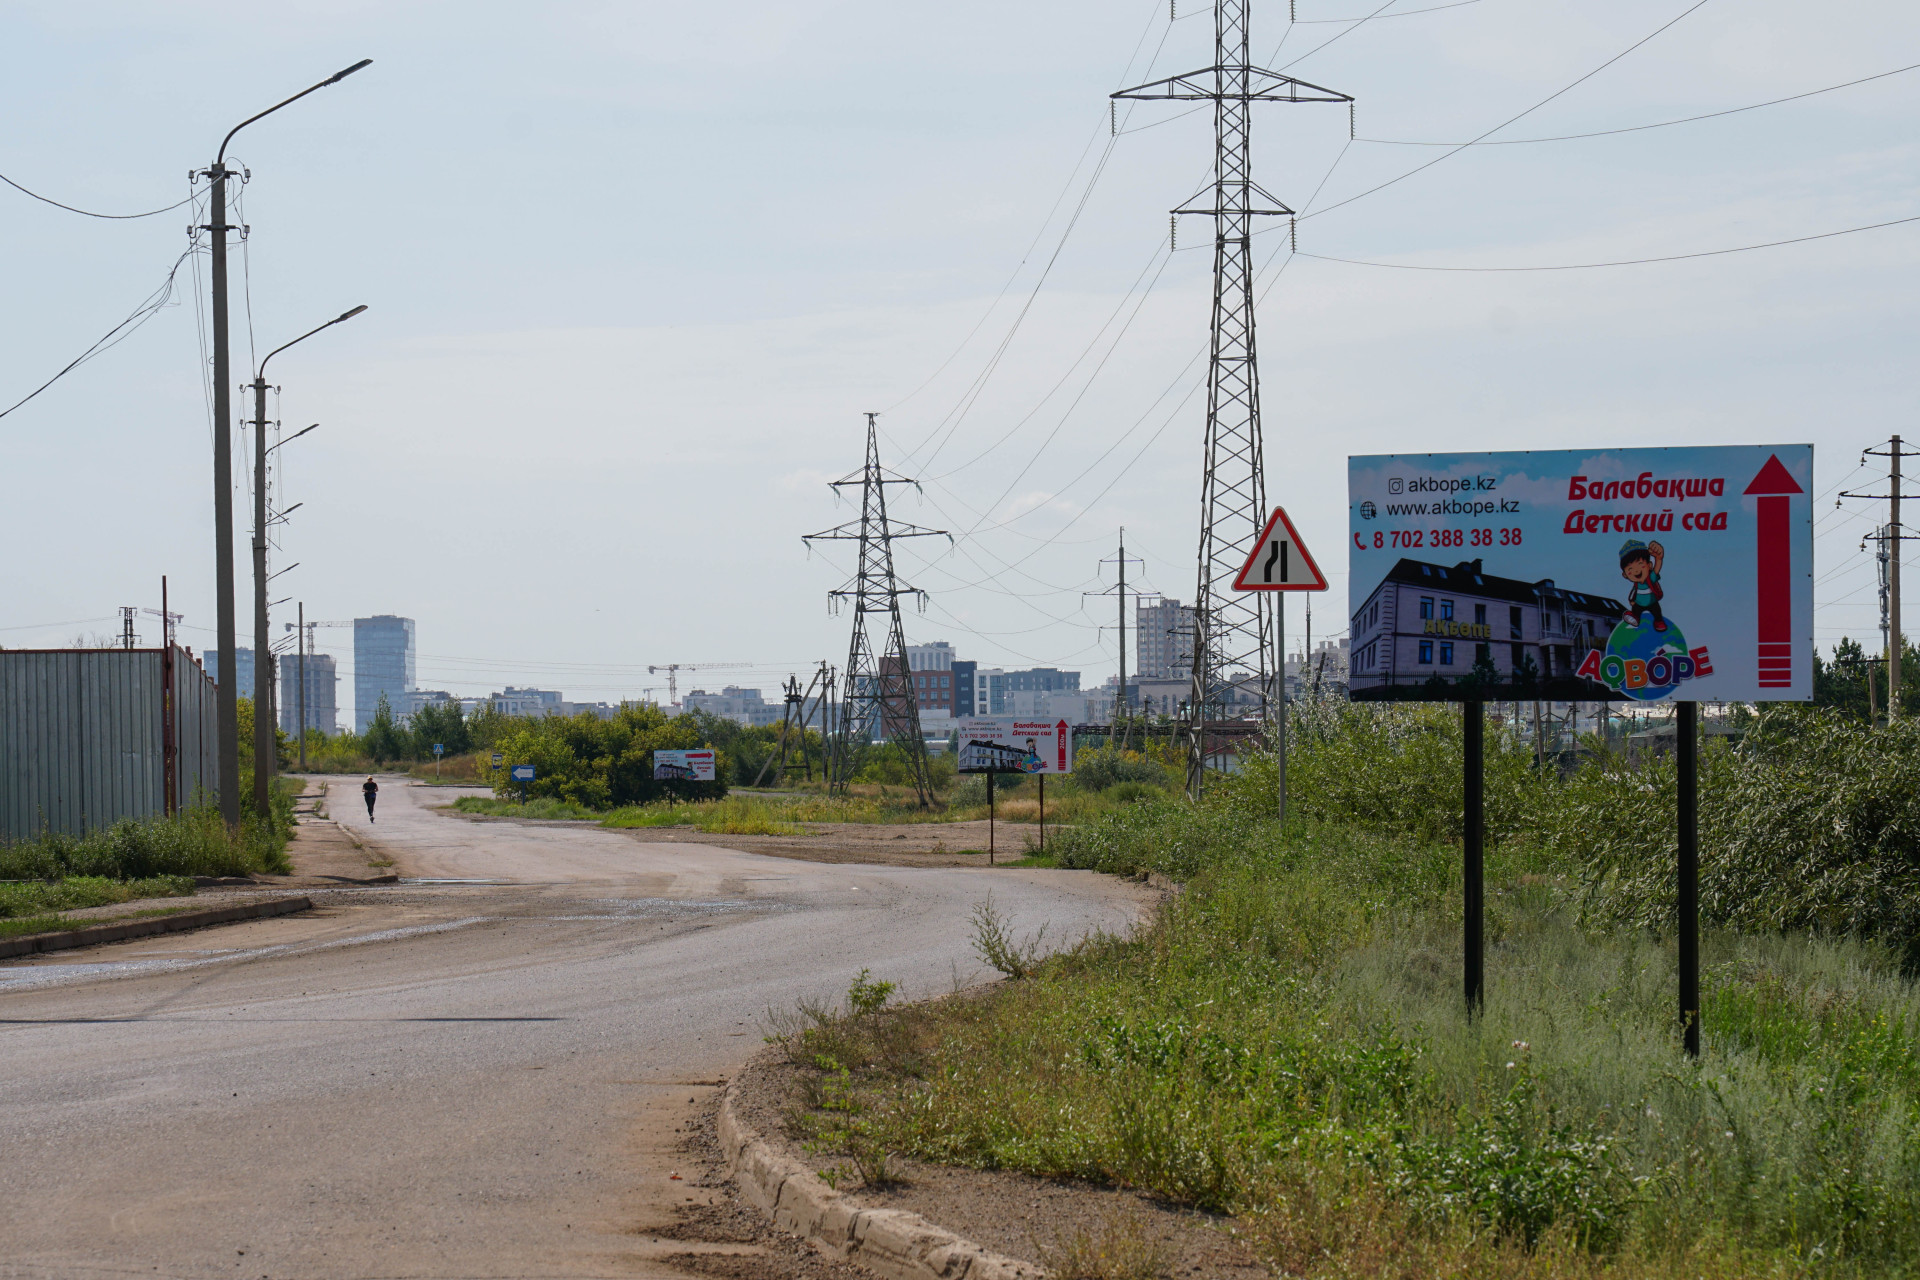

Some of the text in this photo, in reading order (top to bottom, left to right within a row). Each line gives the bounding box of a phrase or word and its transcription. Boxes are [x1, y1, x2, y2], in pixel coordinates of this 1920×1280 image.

[1408, 475, 1496, 494] akbope.kz
[1568, 471, 1725, 502] Балабақша
[1386, 498, 1520, 517] www.akbope.kz
[1563, 509, 1728, 534] Детский сад
[1373, 527, 1522, 549] 8 702 388 38 38
